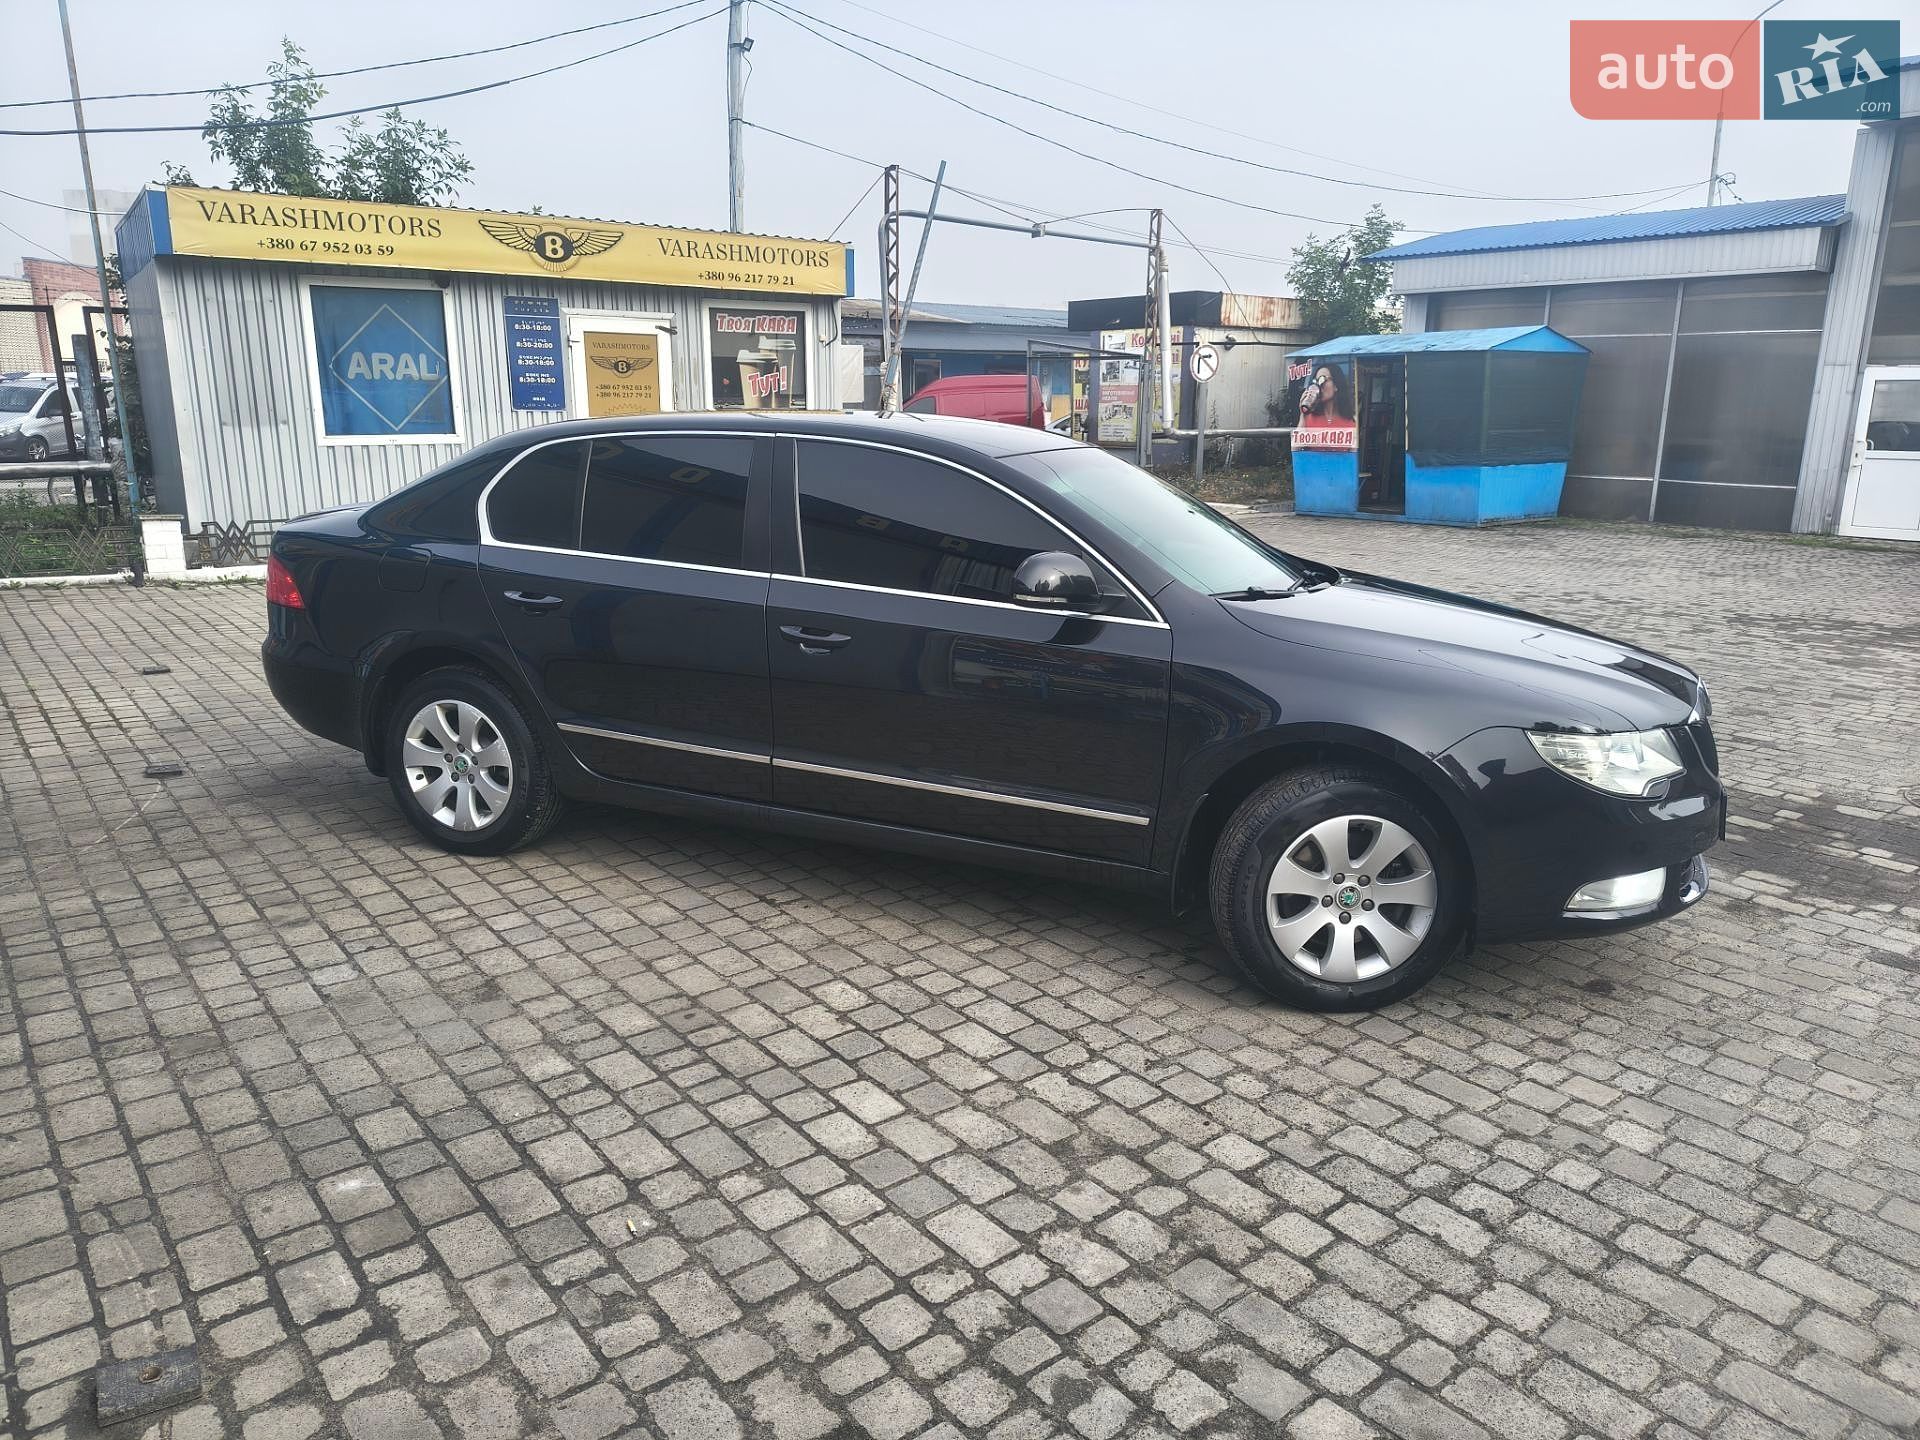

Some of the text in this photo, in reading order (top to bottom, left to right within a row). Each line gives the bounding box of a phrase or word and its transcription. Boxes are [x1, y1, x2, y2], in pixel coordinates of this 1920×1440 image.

[197, 200, 442, 238] VARASHMOTORS
[256, 238, 395, 256] +380 67 952 03 59
[544, 235, 565, 259] B
[657, 238, 829, 267] VARASHMOTORS
[698, 271, 795, 286] +380 96 217 79 21
[592, 342, 651, 350] VARASHMOTORS
[347, 352, 439, 380] ARAL
[1321, 430, 1353, 445] КАВА
